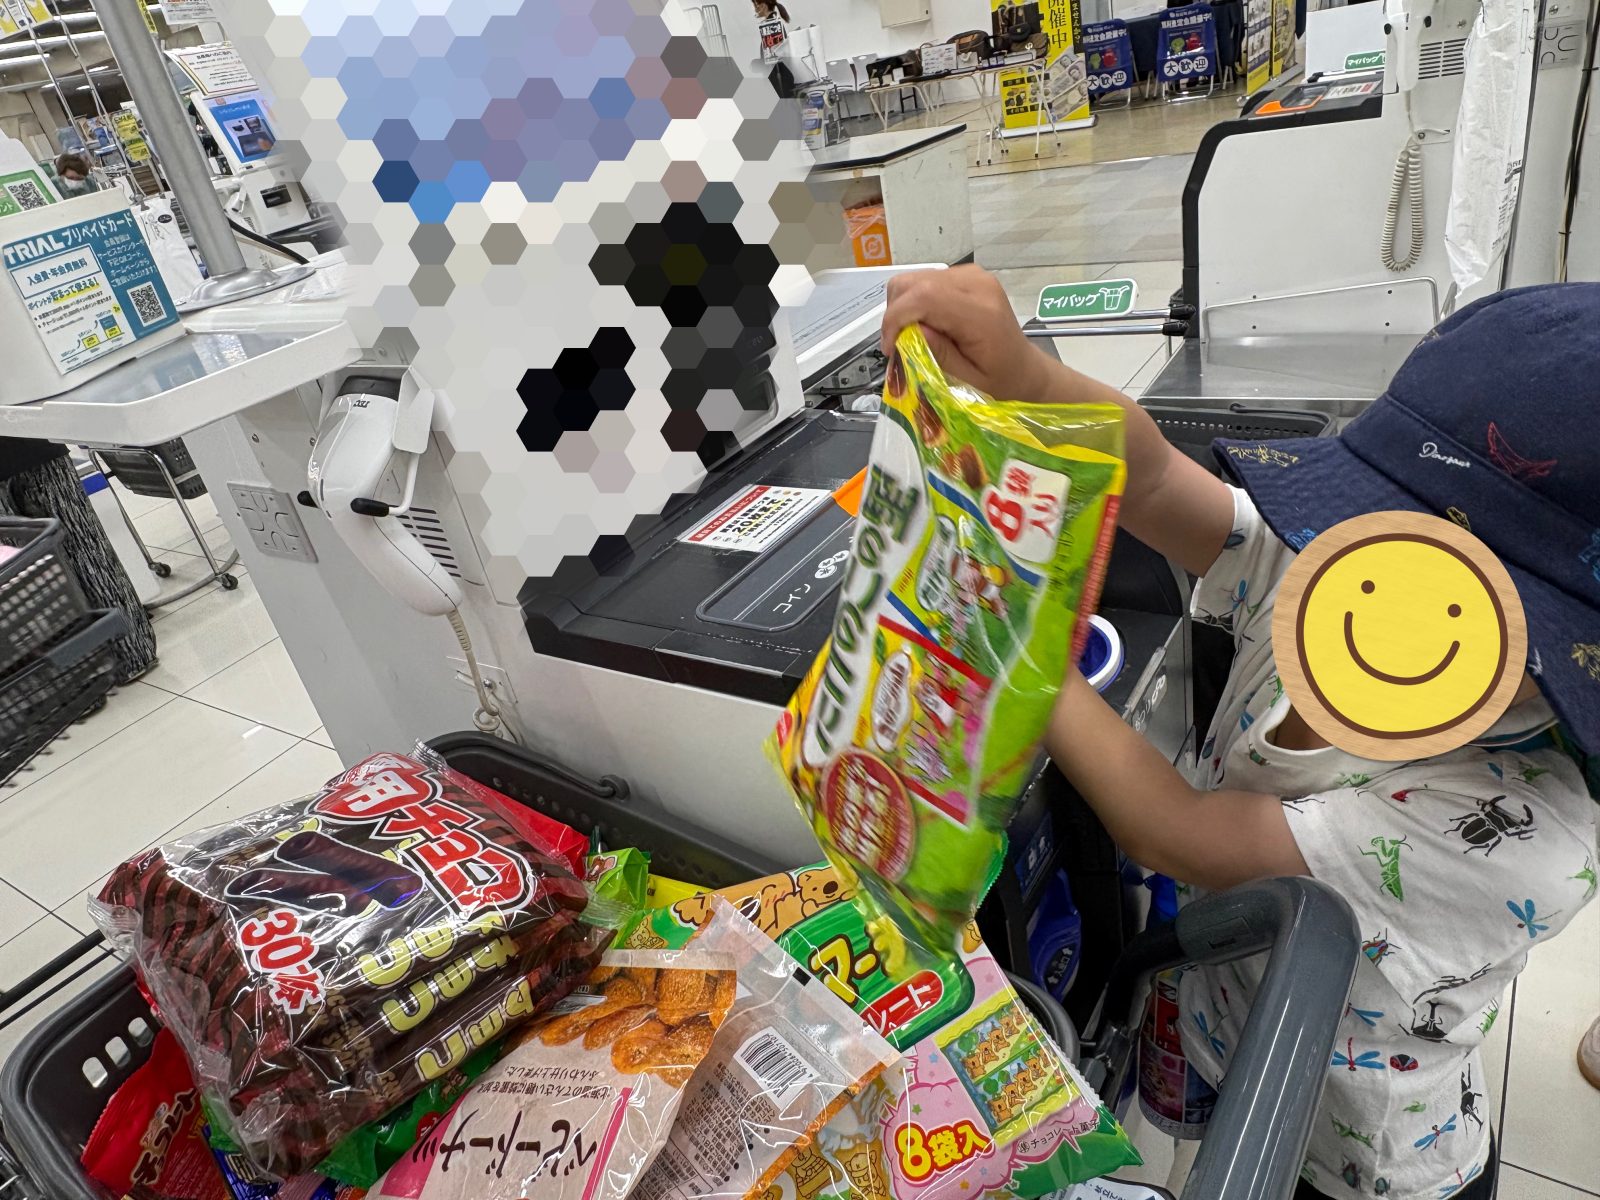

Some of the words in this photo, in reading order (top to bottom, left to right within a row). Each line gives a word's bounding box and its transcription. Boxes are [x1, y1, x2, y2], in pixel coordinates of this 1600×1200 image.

[1087, 71, 1126, 89] 大歓迎
[1166, 58, 1207, 75] 大歓迎
[3, 235, 66, 265] TRIAL
[62, 213, 133, 245] プリペイドカード
[1043, 293, 1101, 310] マイバッグ
[732, 498, 782, 534] 20枚まで
[773, 583, 811, 613] コイン
[241, 911, 324, 1012] 30本
[866, 980, 933, 1034] レート
[895, 1122, 994, 1181] 8袋入
[1030, 1118, 1100, 1151] チョコレート菓子
